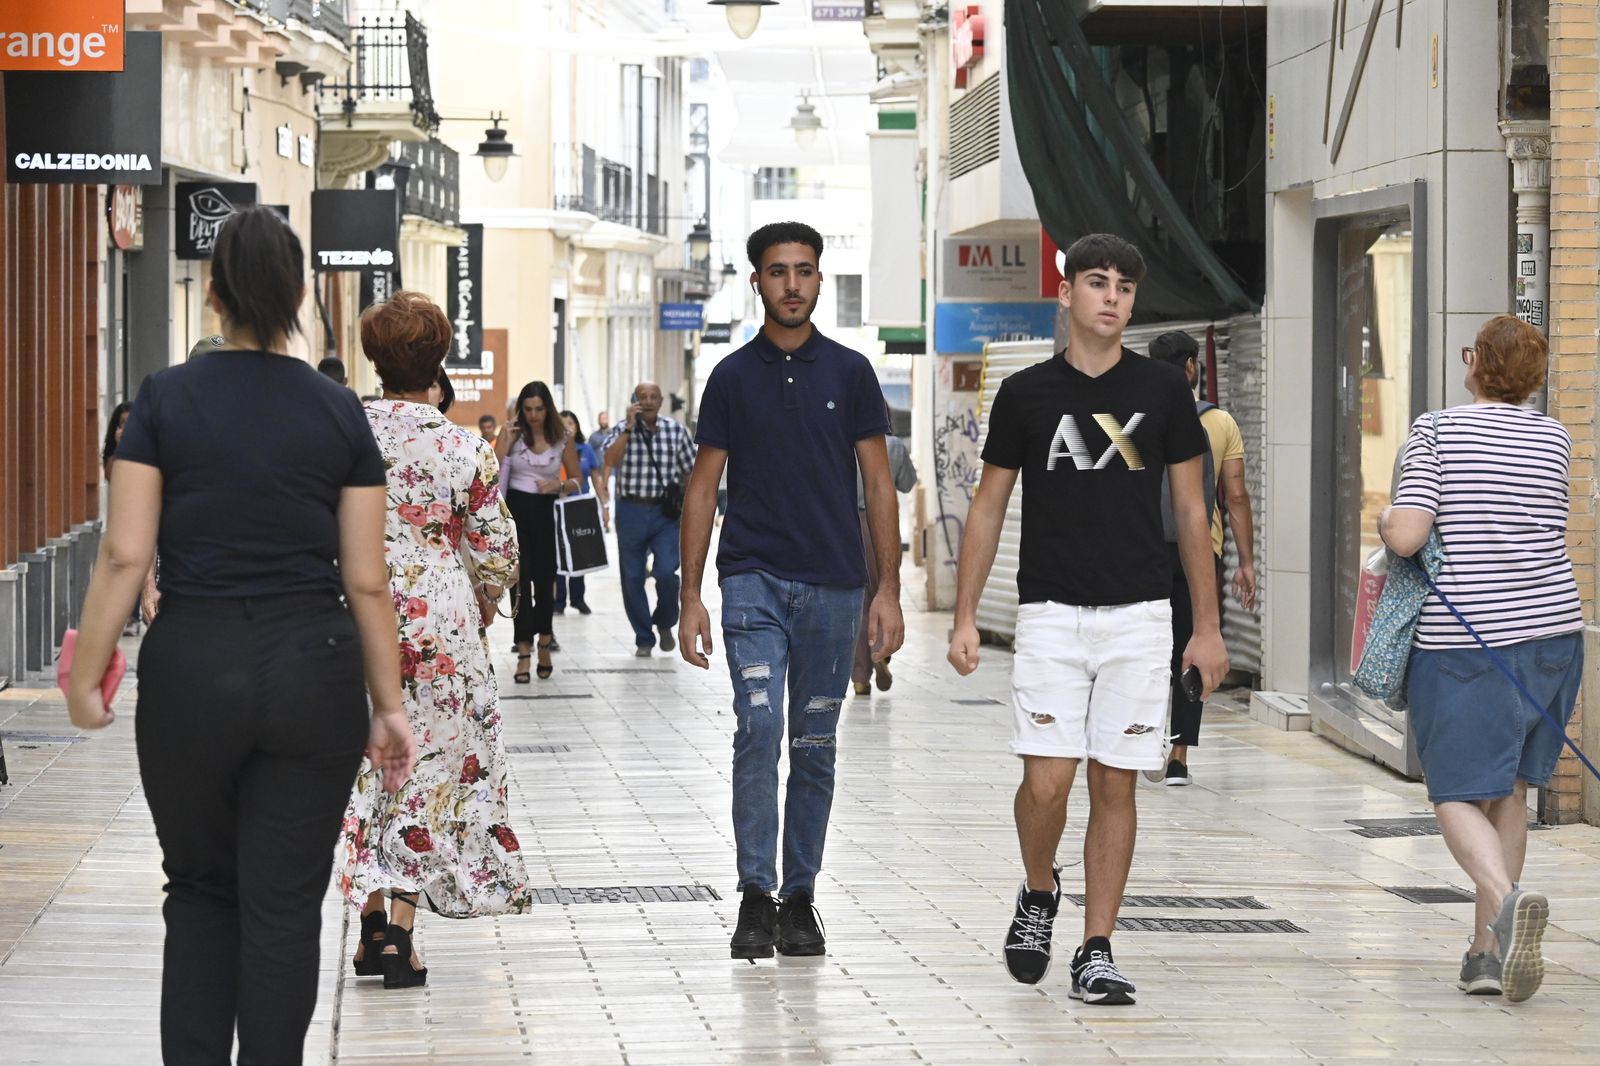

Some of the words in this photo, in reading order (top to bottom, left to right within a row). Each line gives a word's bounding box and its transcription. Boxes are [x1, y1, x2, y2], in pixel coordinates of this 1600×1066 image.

[15, 153, 152, 171] CALZEDONIA
[190, 212, 225, 240] BRUT
[318, 247, 394, 265] TEZENIS
[1047, 412, 1146, 471] AX
